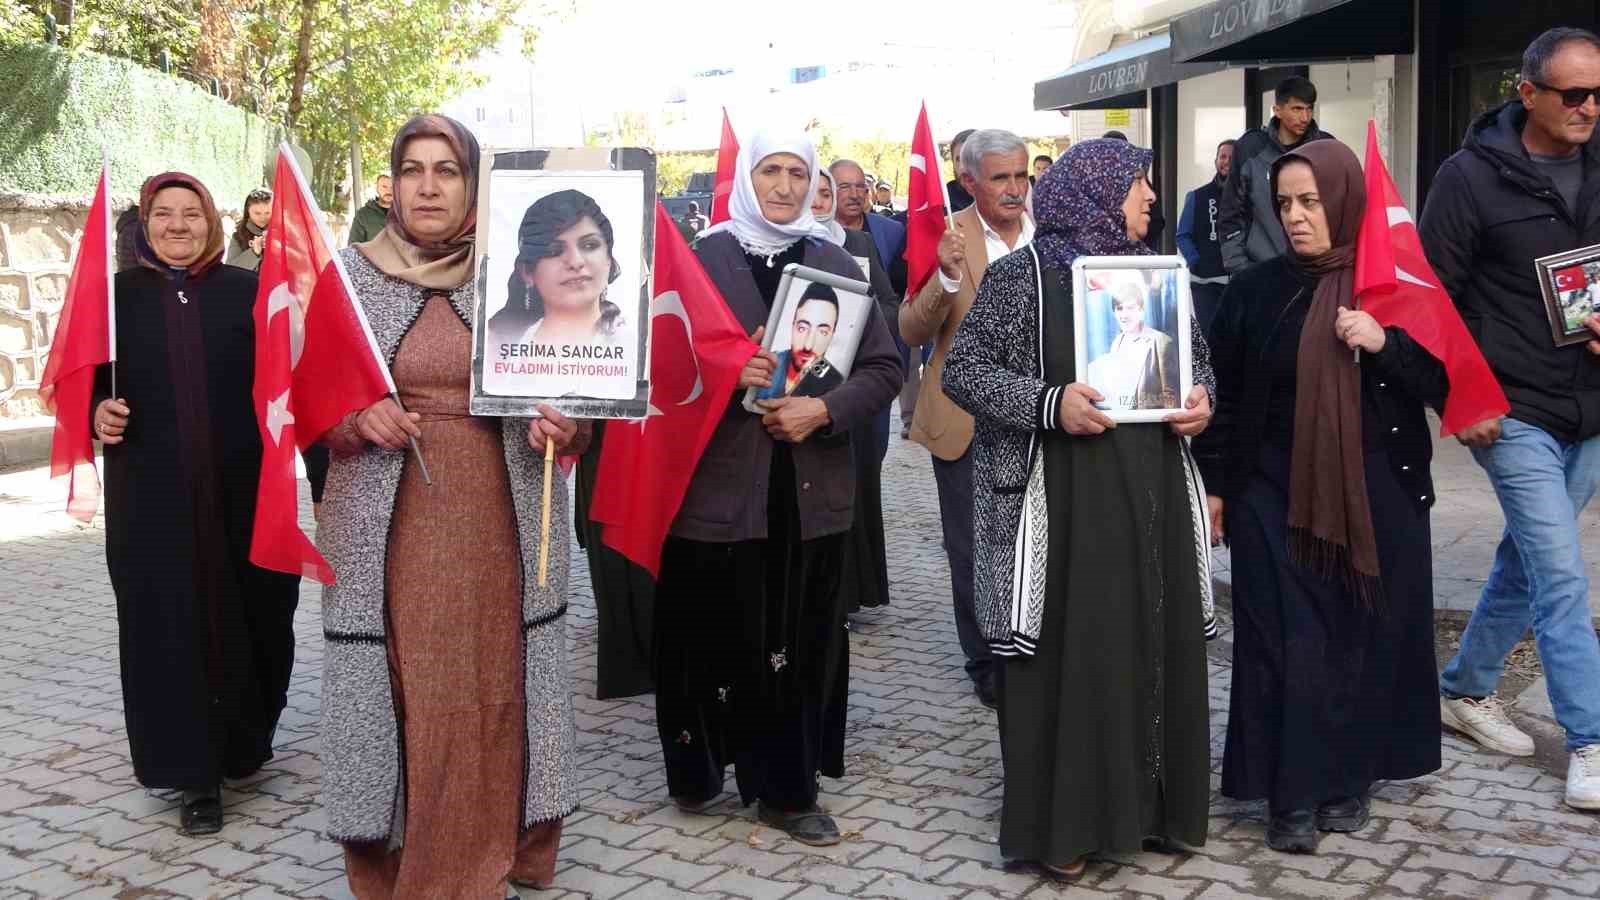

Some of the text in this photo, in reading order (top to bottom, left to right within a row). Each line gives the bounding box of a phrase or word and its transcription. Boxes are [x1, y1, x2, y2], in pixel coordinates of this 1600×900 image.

[1088, 60, 1149, 93] LOVREN
[500, 341, 624, 360] ŞERİMA SANCAR
[495, 361, 628, 376] EVLADIMI İSTİYORUM!
